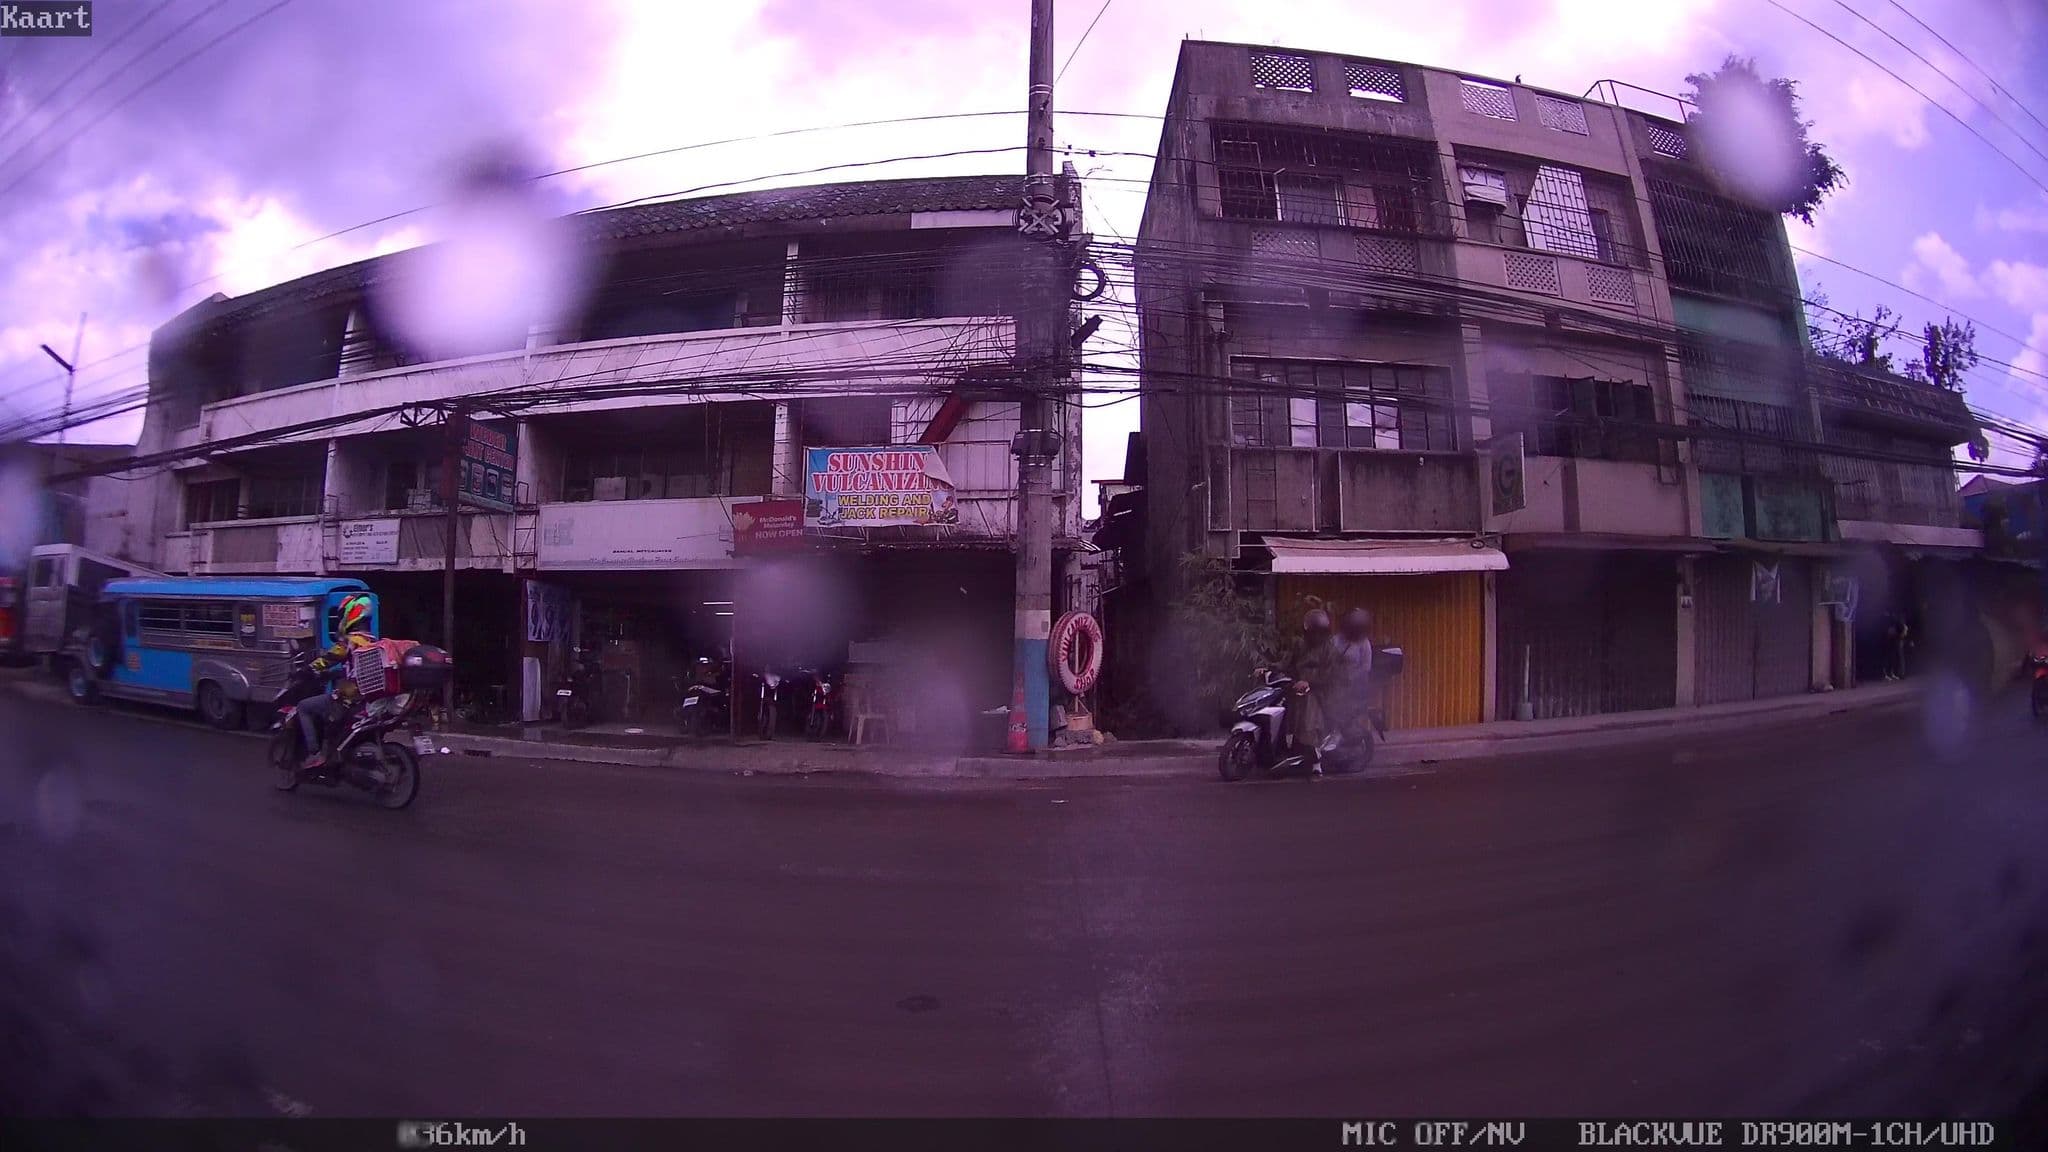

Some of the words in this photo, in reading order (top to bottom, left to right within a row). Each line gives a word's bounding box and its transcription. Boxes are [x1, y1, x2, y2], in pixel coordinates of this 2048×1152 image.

[828, 452, 927, 472] SUNSHIN
[838, 494, 898, 507] WELDING
[902, 493, 931, 506] AND
[839, 506, 875, 520] JACK
[879, 506, 928, 519] REPAIR
[755, 530, 777, 539] NOW
[778, 529, 803, 537] OPEN
[1073, 668, 1096, 690] SHOP
